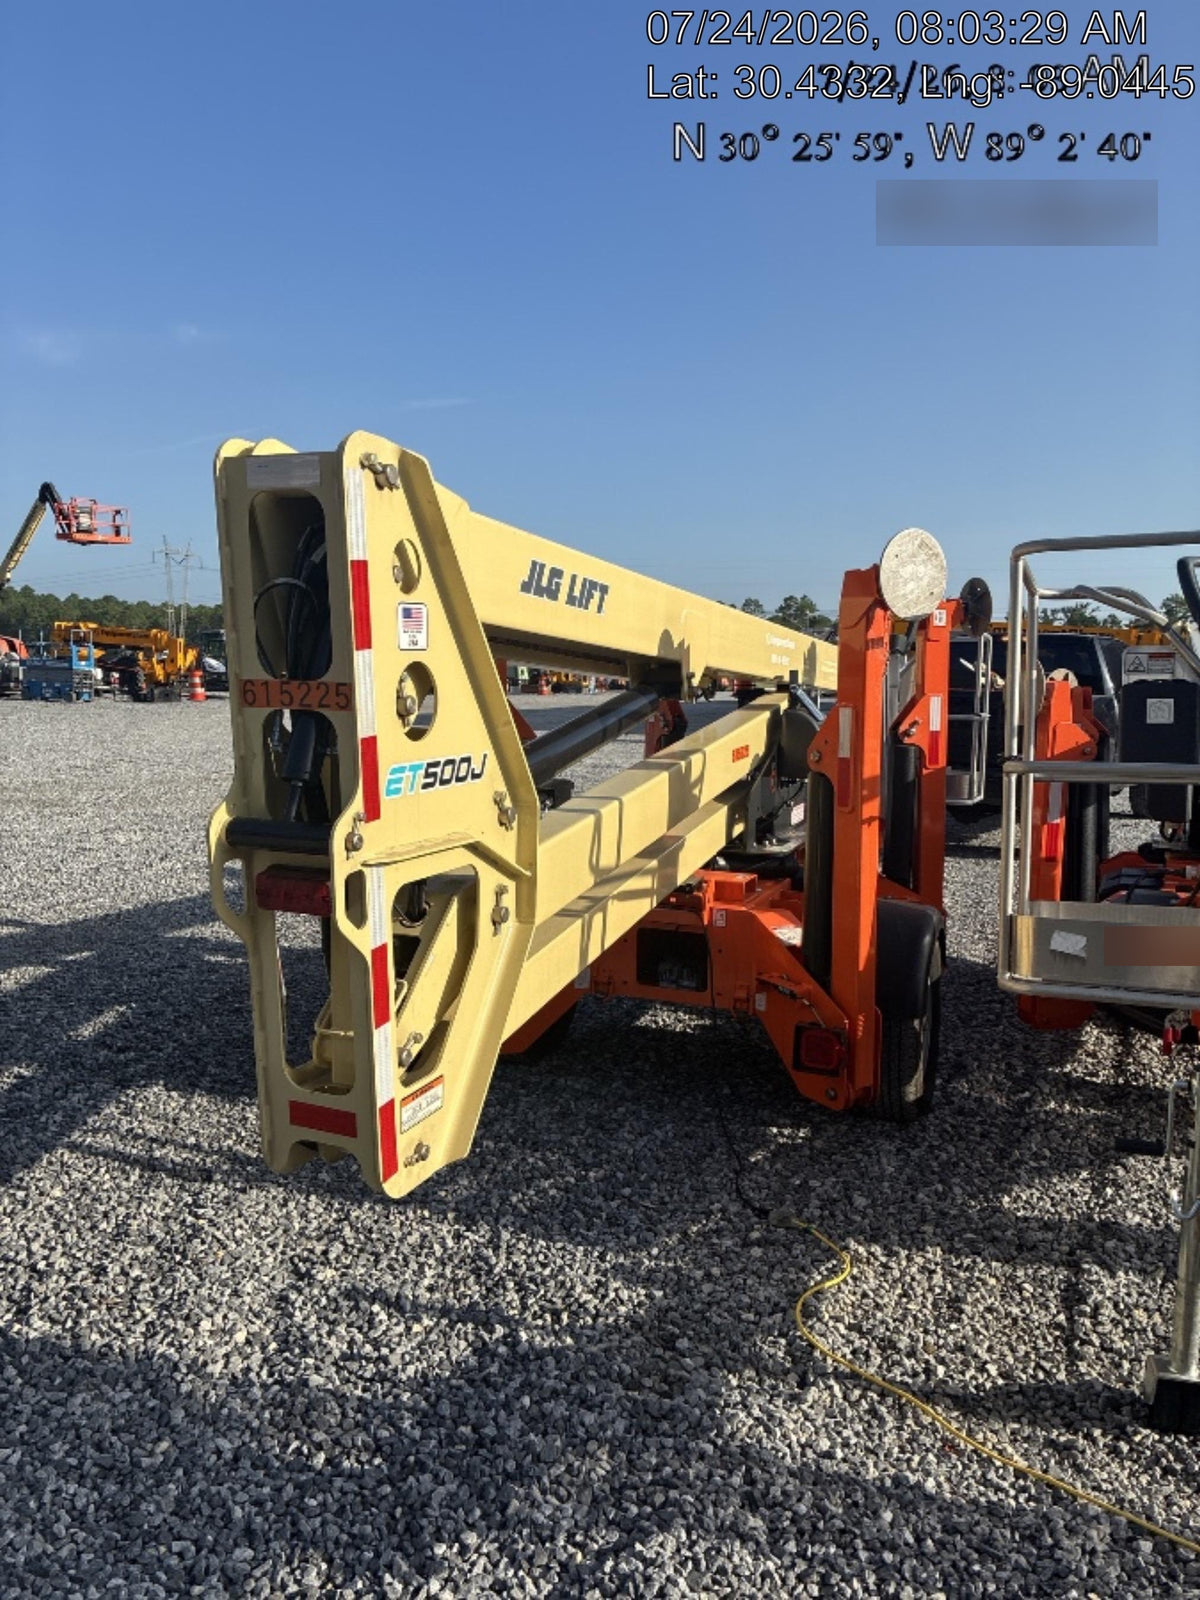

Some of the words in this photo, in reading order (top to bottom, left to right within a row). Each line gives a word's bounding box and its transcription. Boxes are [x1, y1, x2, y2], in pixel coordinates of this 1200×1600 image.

[520, 559, 564, 602] JLG
[565, 573, 609, 614] LIFT
[242, 680, 350, 709] 615225
[385, 753, 488, 797] ET500J
